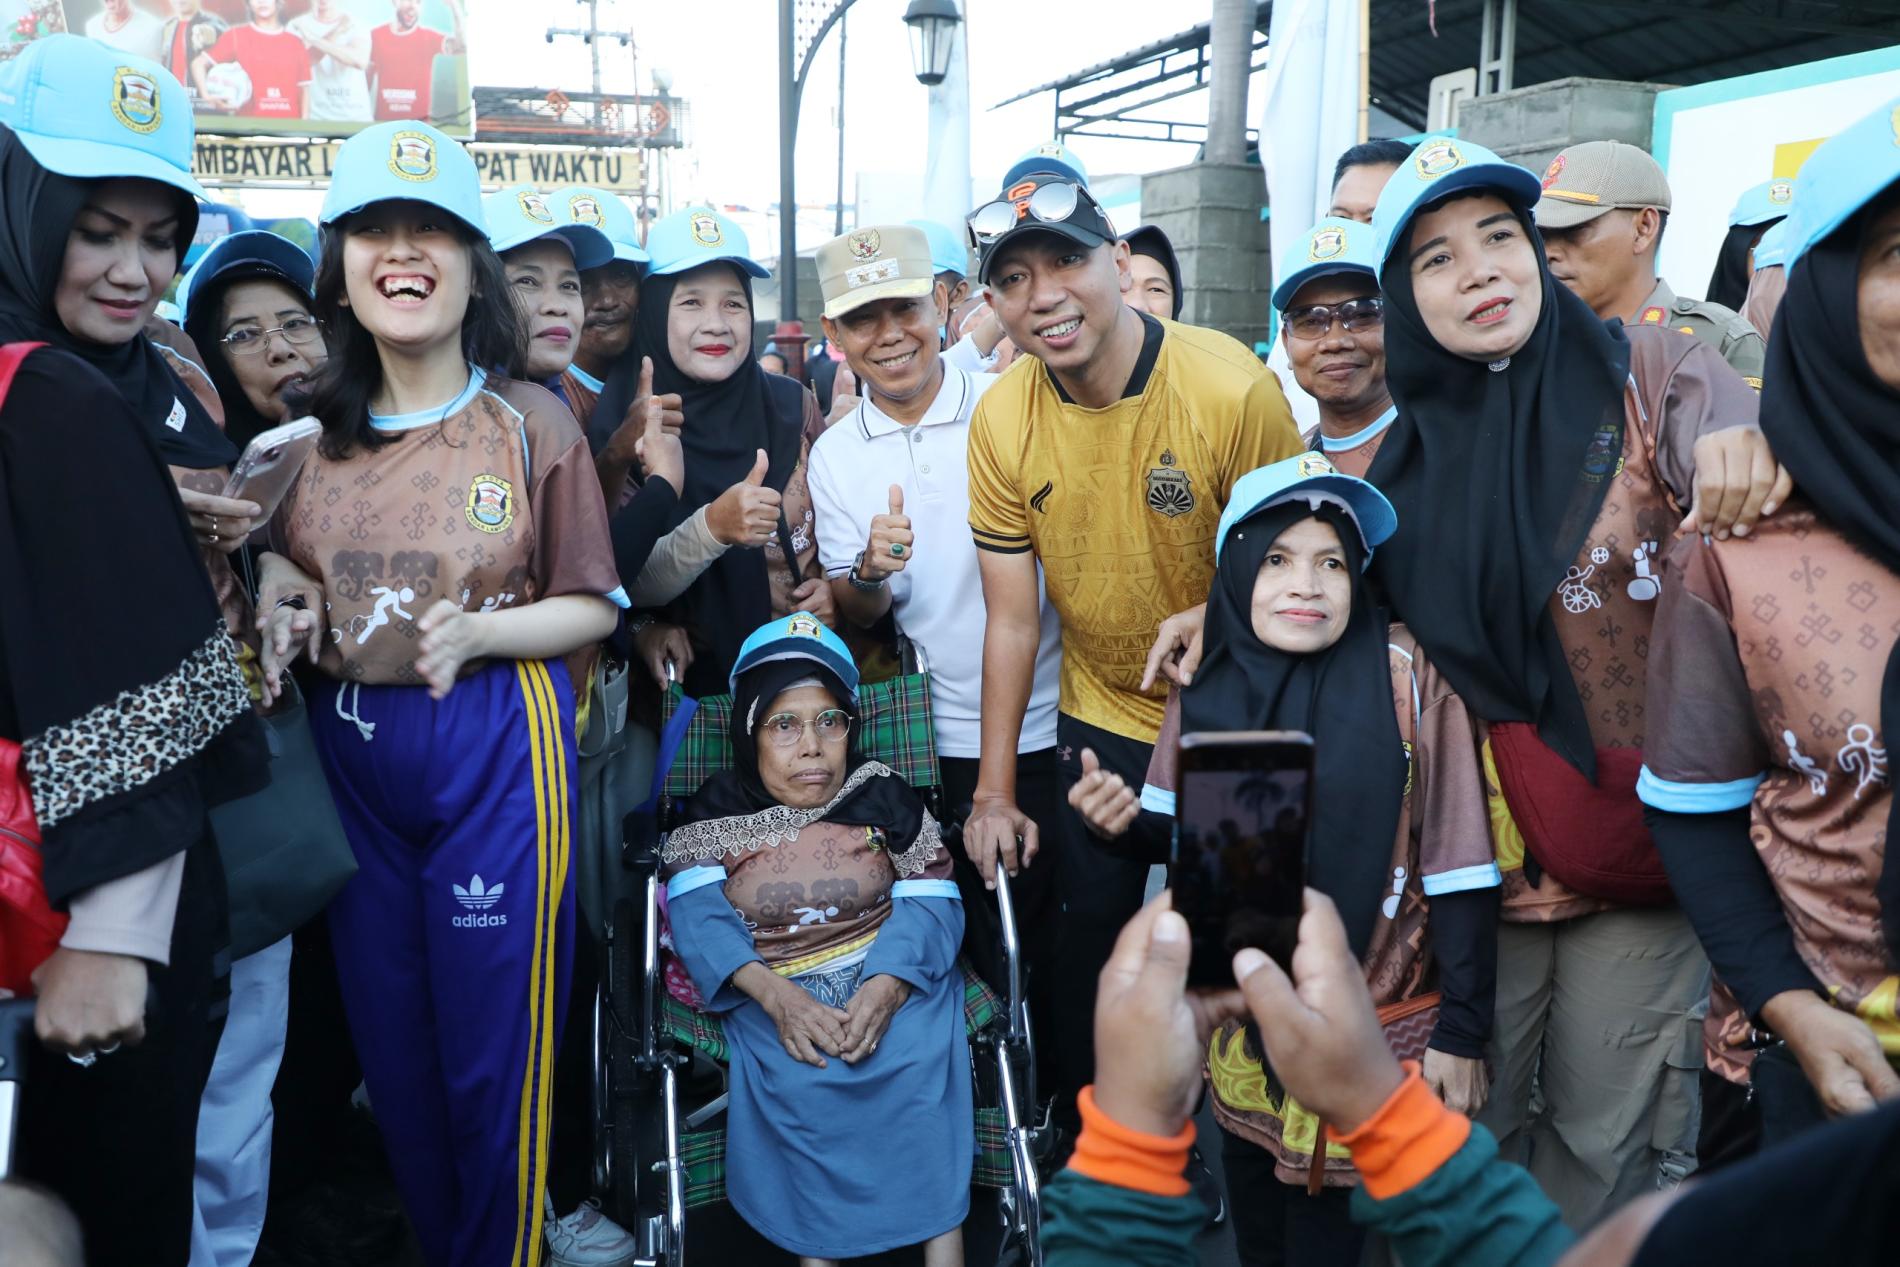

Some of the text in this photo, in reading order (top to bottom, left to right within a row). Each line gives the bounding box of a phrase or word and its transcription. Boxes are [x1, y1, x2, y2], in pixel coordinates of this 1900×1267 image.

[191, 143, 313, 177] MBAYAR
[475, 150, 520, 182] PAT
[529, 153, 622, 184] WAKTU
[451, 912, 508, 928] adidas
